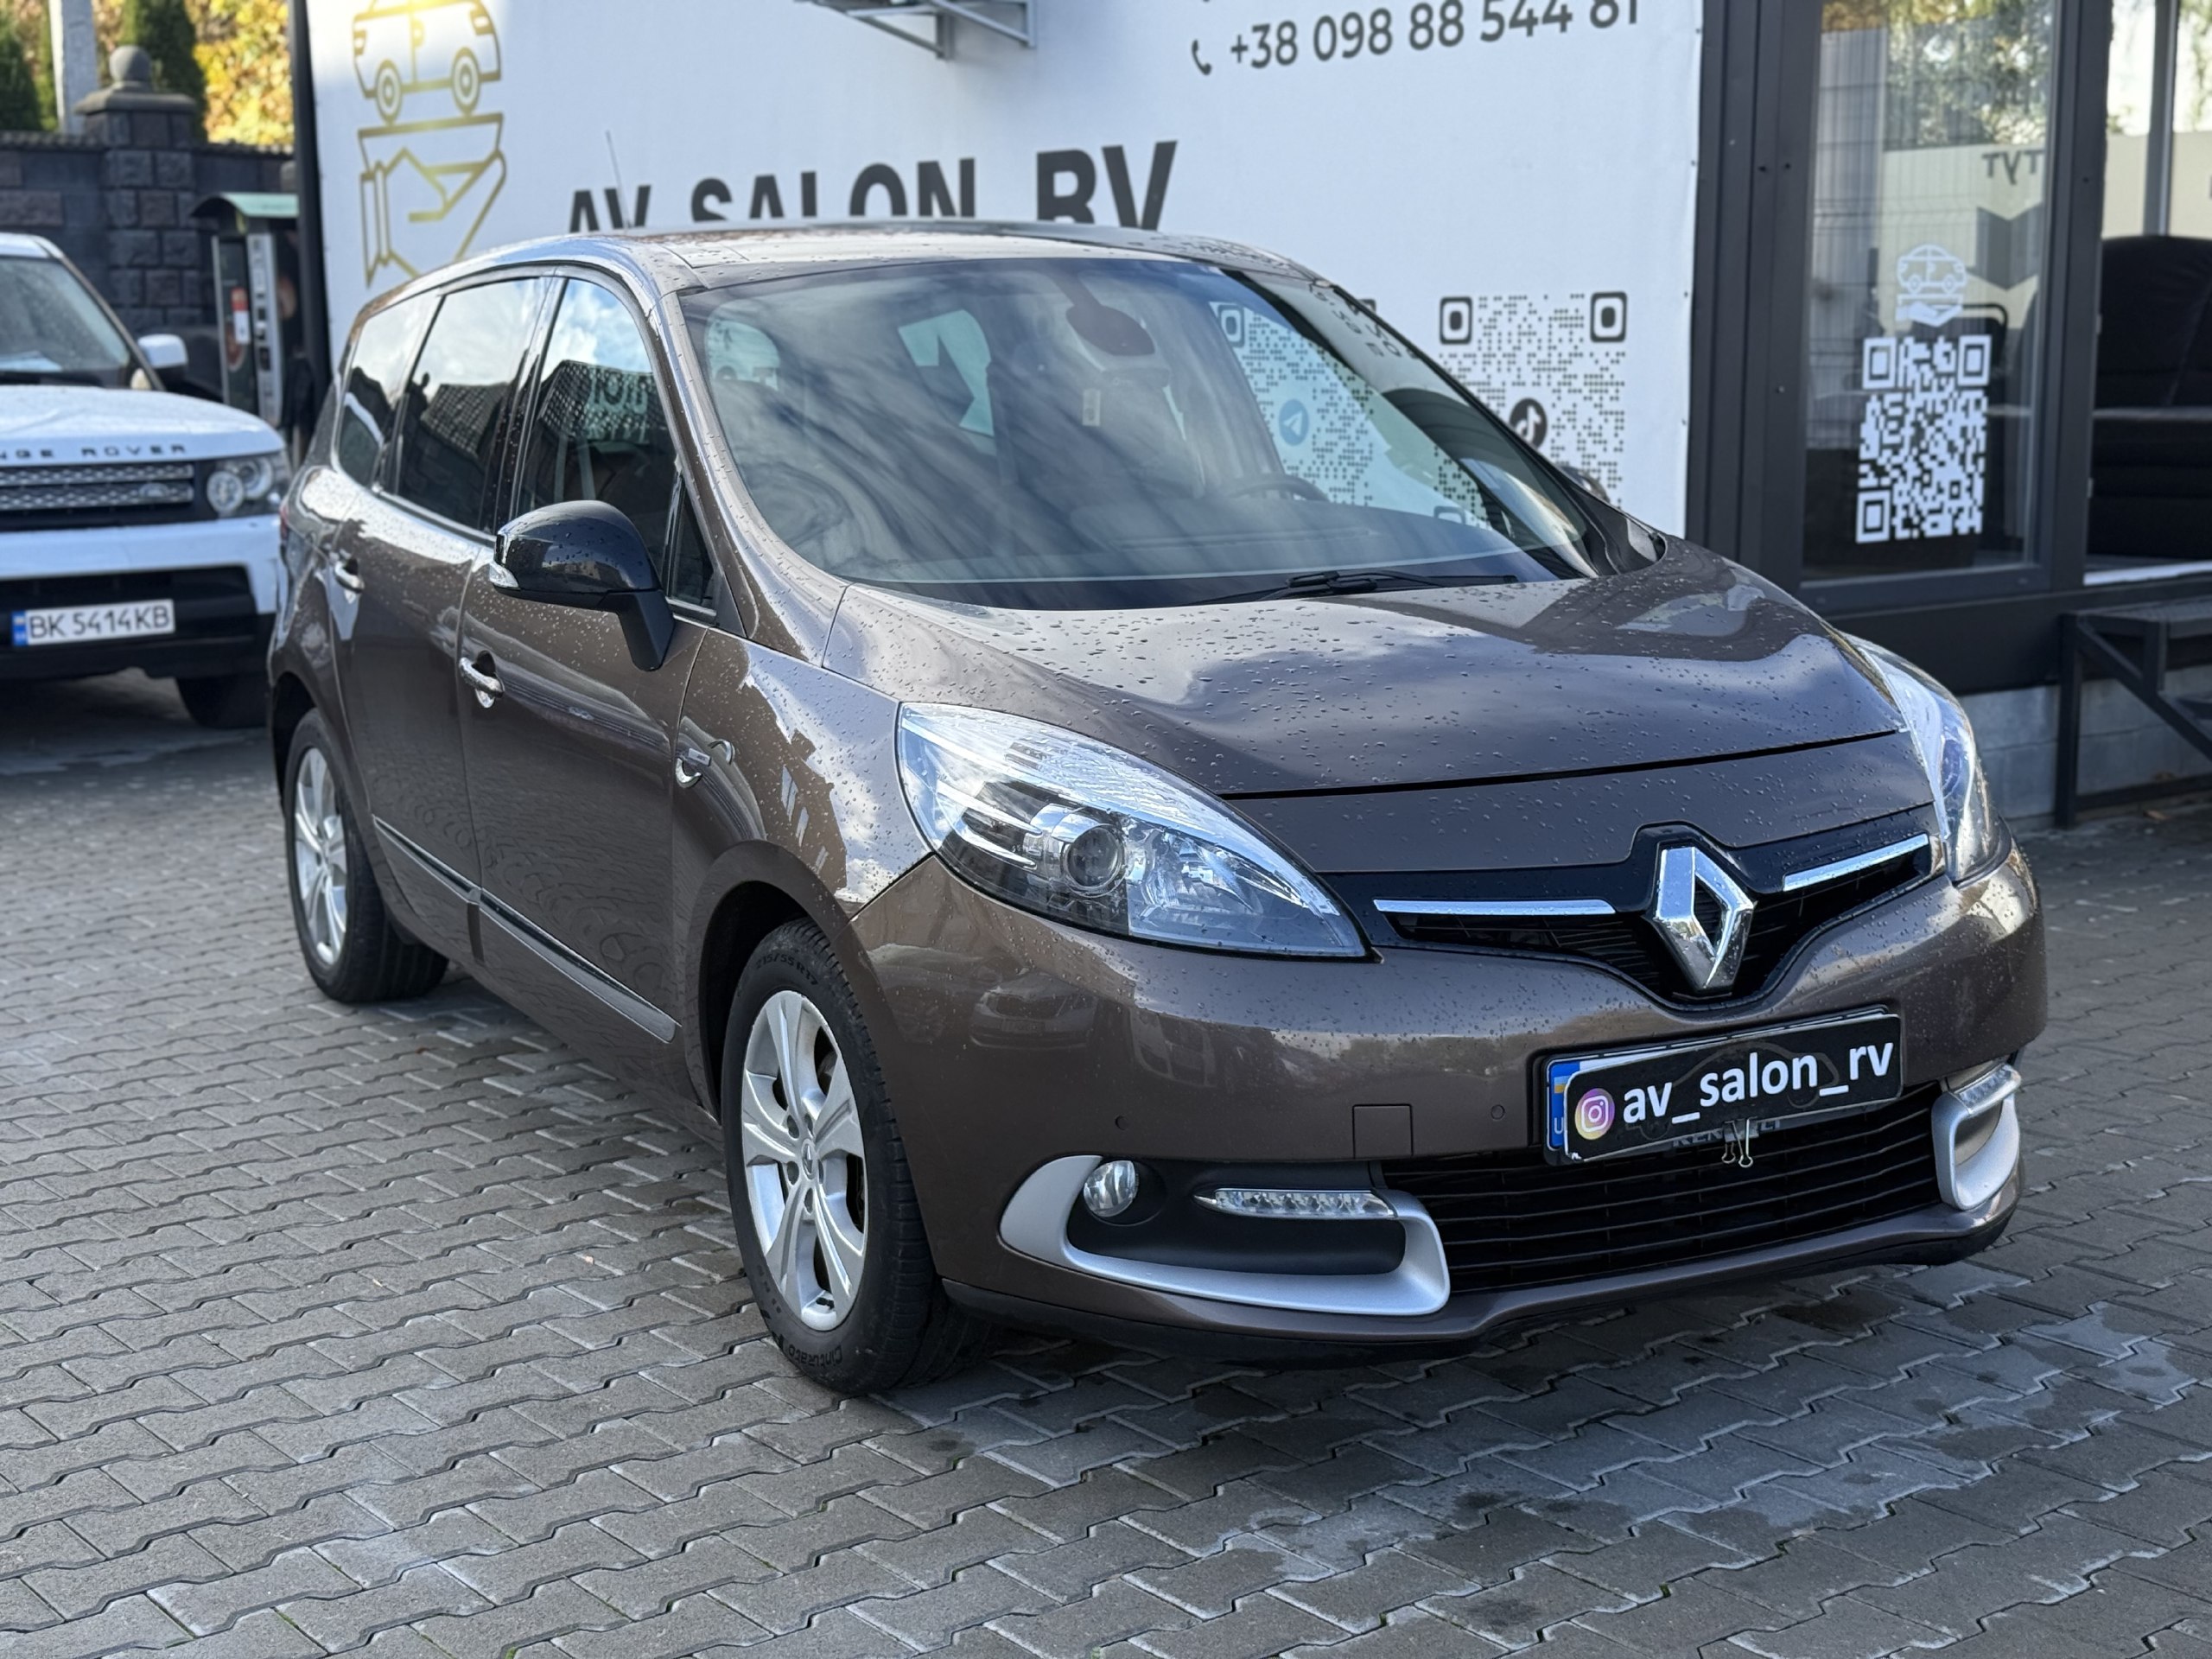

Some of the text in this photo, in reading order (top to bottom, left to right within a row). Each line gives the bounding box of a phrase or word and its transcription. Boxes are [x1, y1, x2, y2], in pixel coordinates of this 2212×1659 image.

[1230, 21, 1298, 69] +38
[1313, 9, 1393, 61] 098
[1409, 3, 1465, 50] 88
[1480, 0, 1573, 41] 544
[81, 444, 186, 457] ROVER
[29, 614, 67, 639] BK
[1623, 1042, 1894, 1124] av_salon_rv
